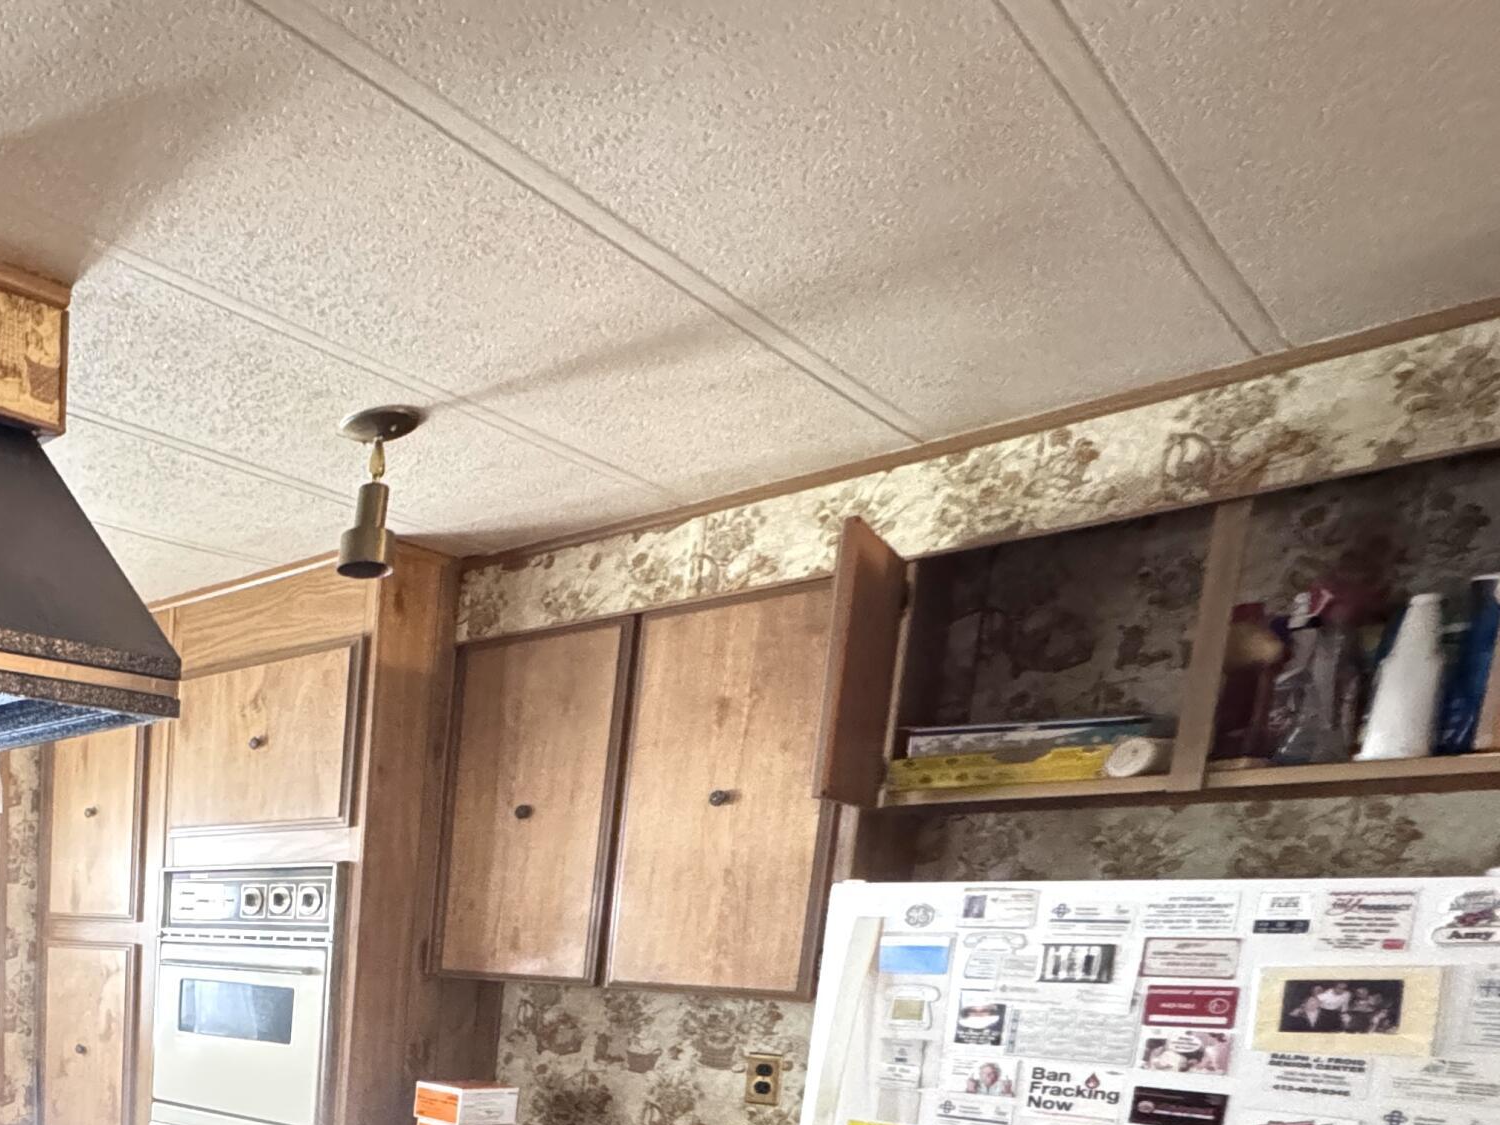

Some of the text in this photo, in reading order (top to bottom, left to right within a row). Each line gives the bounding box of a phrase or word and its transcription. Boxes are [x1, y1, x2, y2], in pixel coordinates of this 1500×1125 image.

[1031, 1067, 1071, 1082] Ban
[1029, 1081, 1120, 1104] Fracking
[1027, 1095, 1073, 1111] Now
